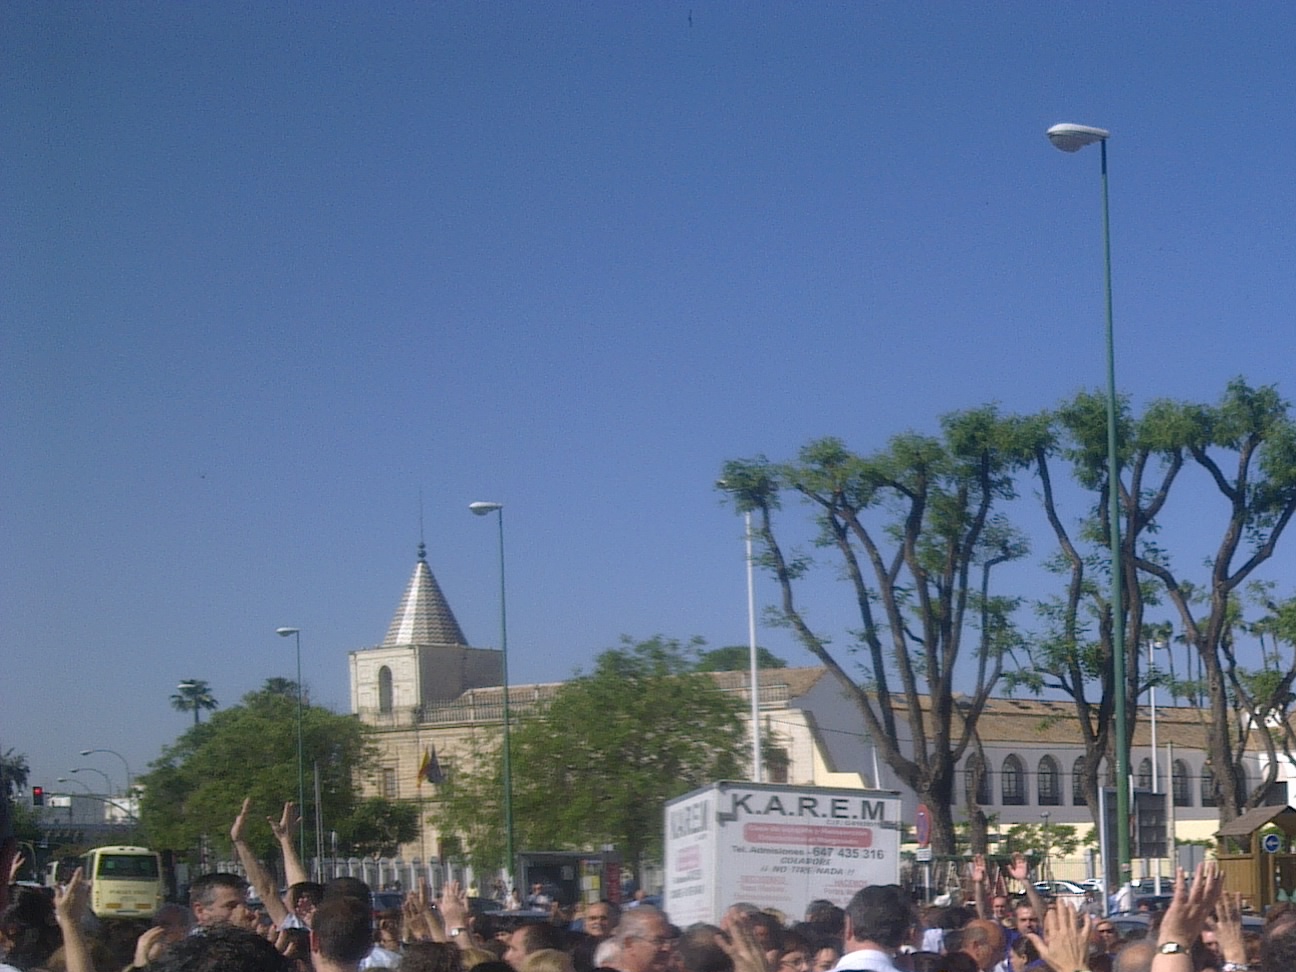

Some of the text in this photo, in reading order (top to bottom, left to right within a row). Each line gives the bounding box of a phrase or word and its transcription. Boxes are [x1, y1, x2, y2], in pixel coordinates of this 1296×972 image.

[813, 847, 834, 857] 647
[838, 848, 859, 858] 435
[863, 849, 885, 860] 316
